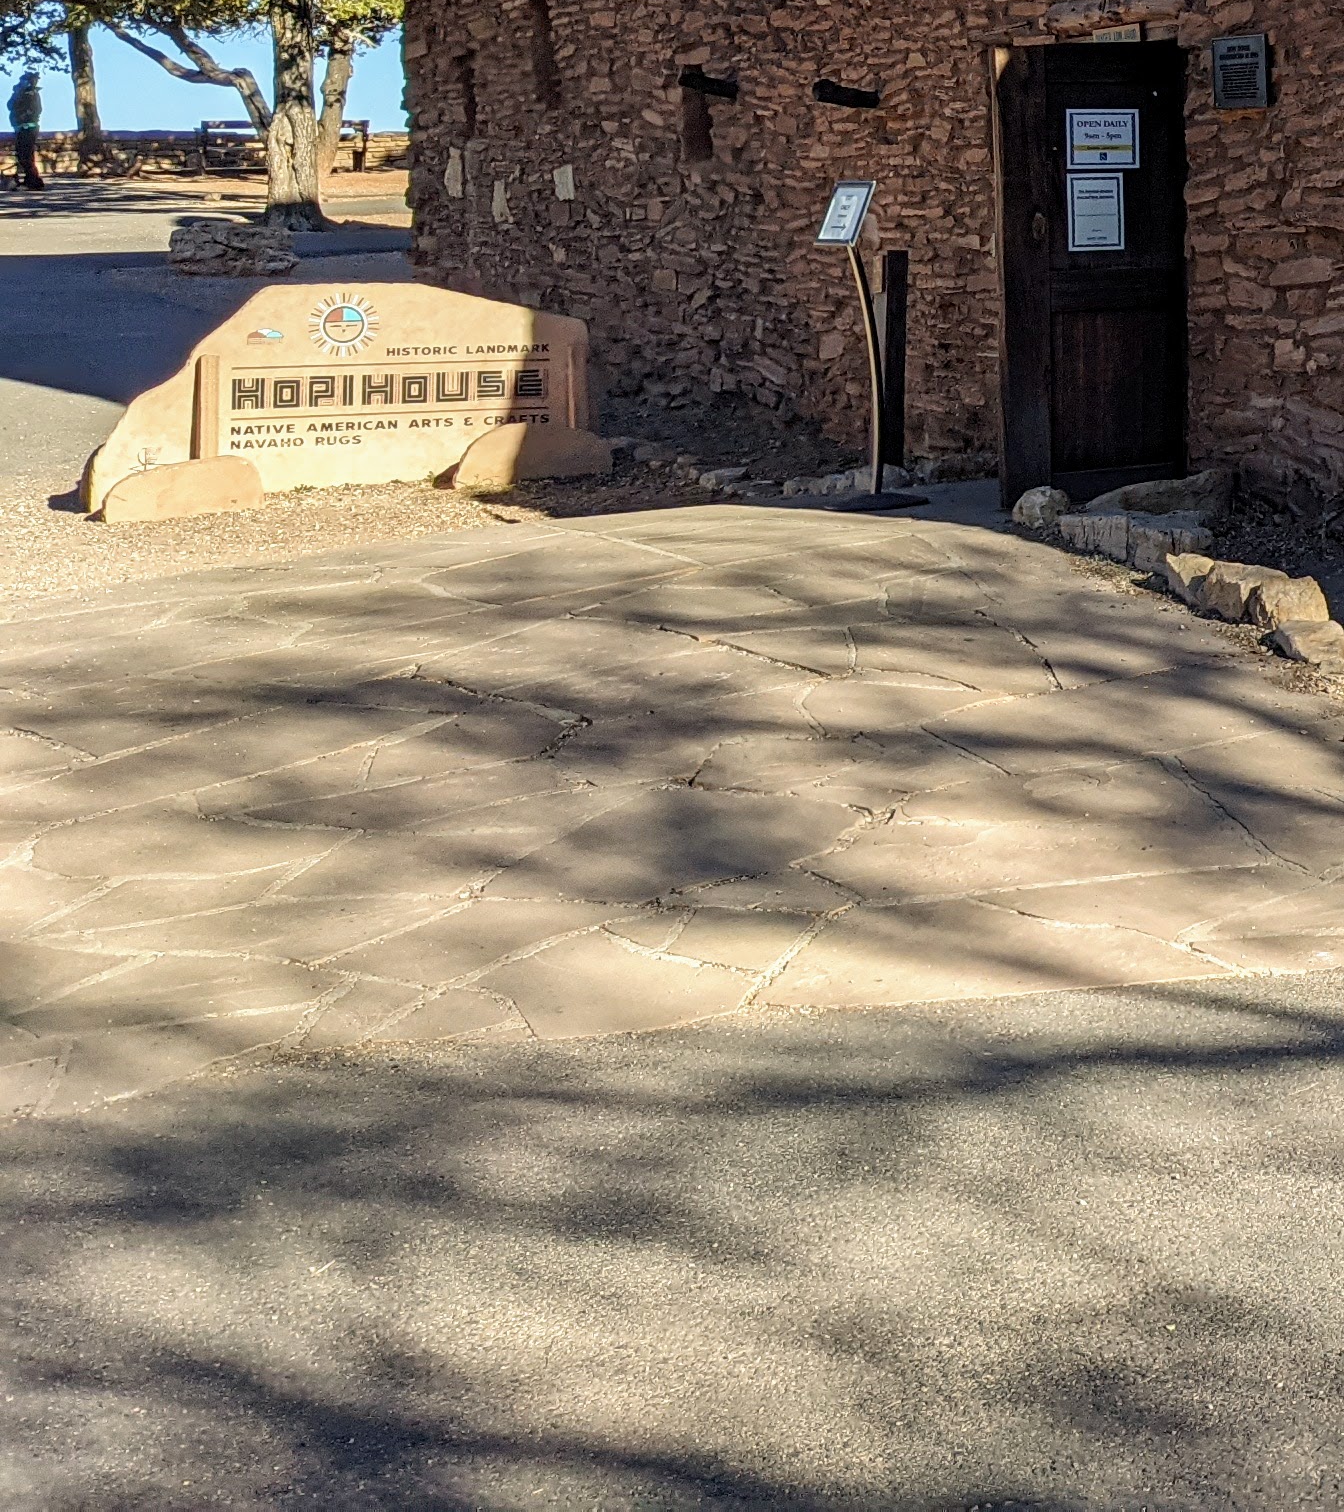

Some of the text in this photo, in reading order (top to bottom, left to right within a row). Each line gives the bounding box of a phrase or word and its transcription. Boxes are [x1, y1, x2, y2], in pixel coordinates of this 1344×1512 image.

[1077, 120, 1128, 128] OPEN DAILY
[386, 343, 550, 357] HISTORIC LANDMARK
[231, 370, 543, 410] HOPI HOUSE
[230, 414, 550, 436] NATIVE AMERICAN ARTS & CRAFTS
[230, 435, 362, 450] NAVAHO RUGS
